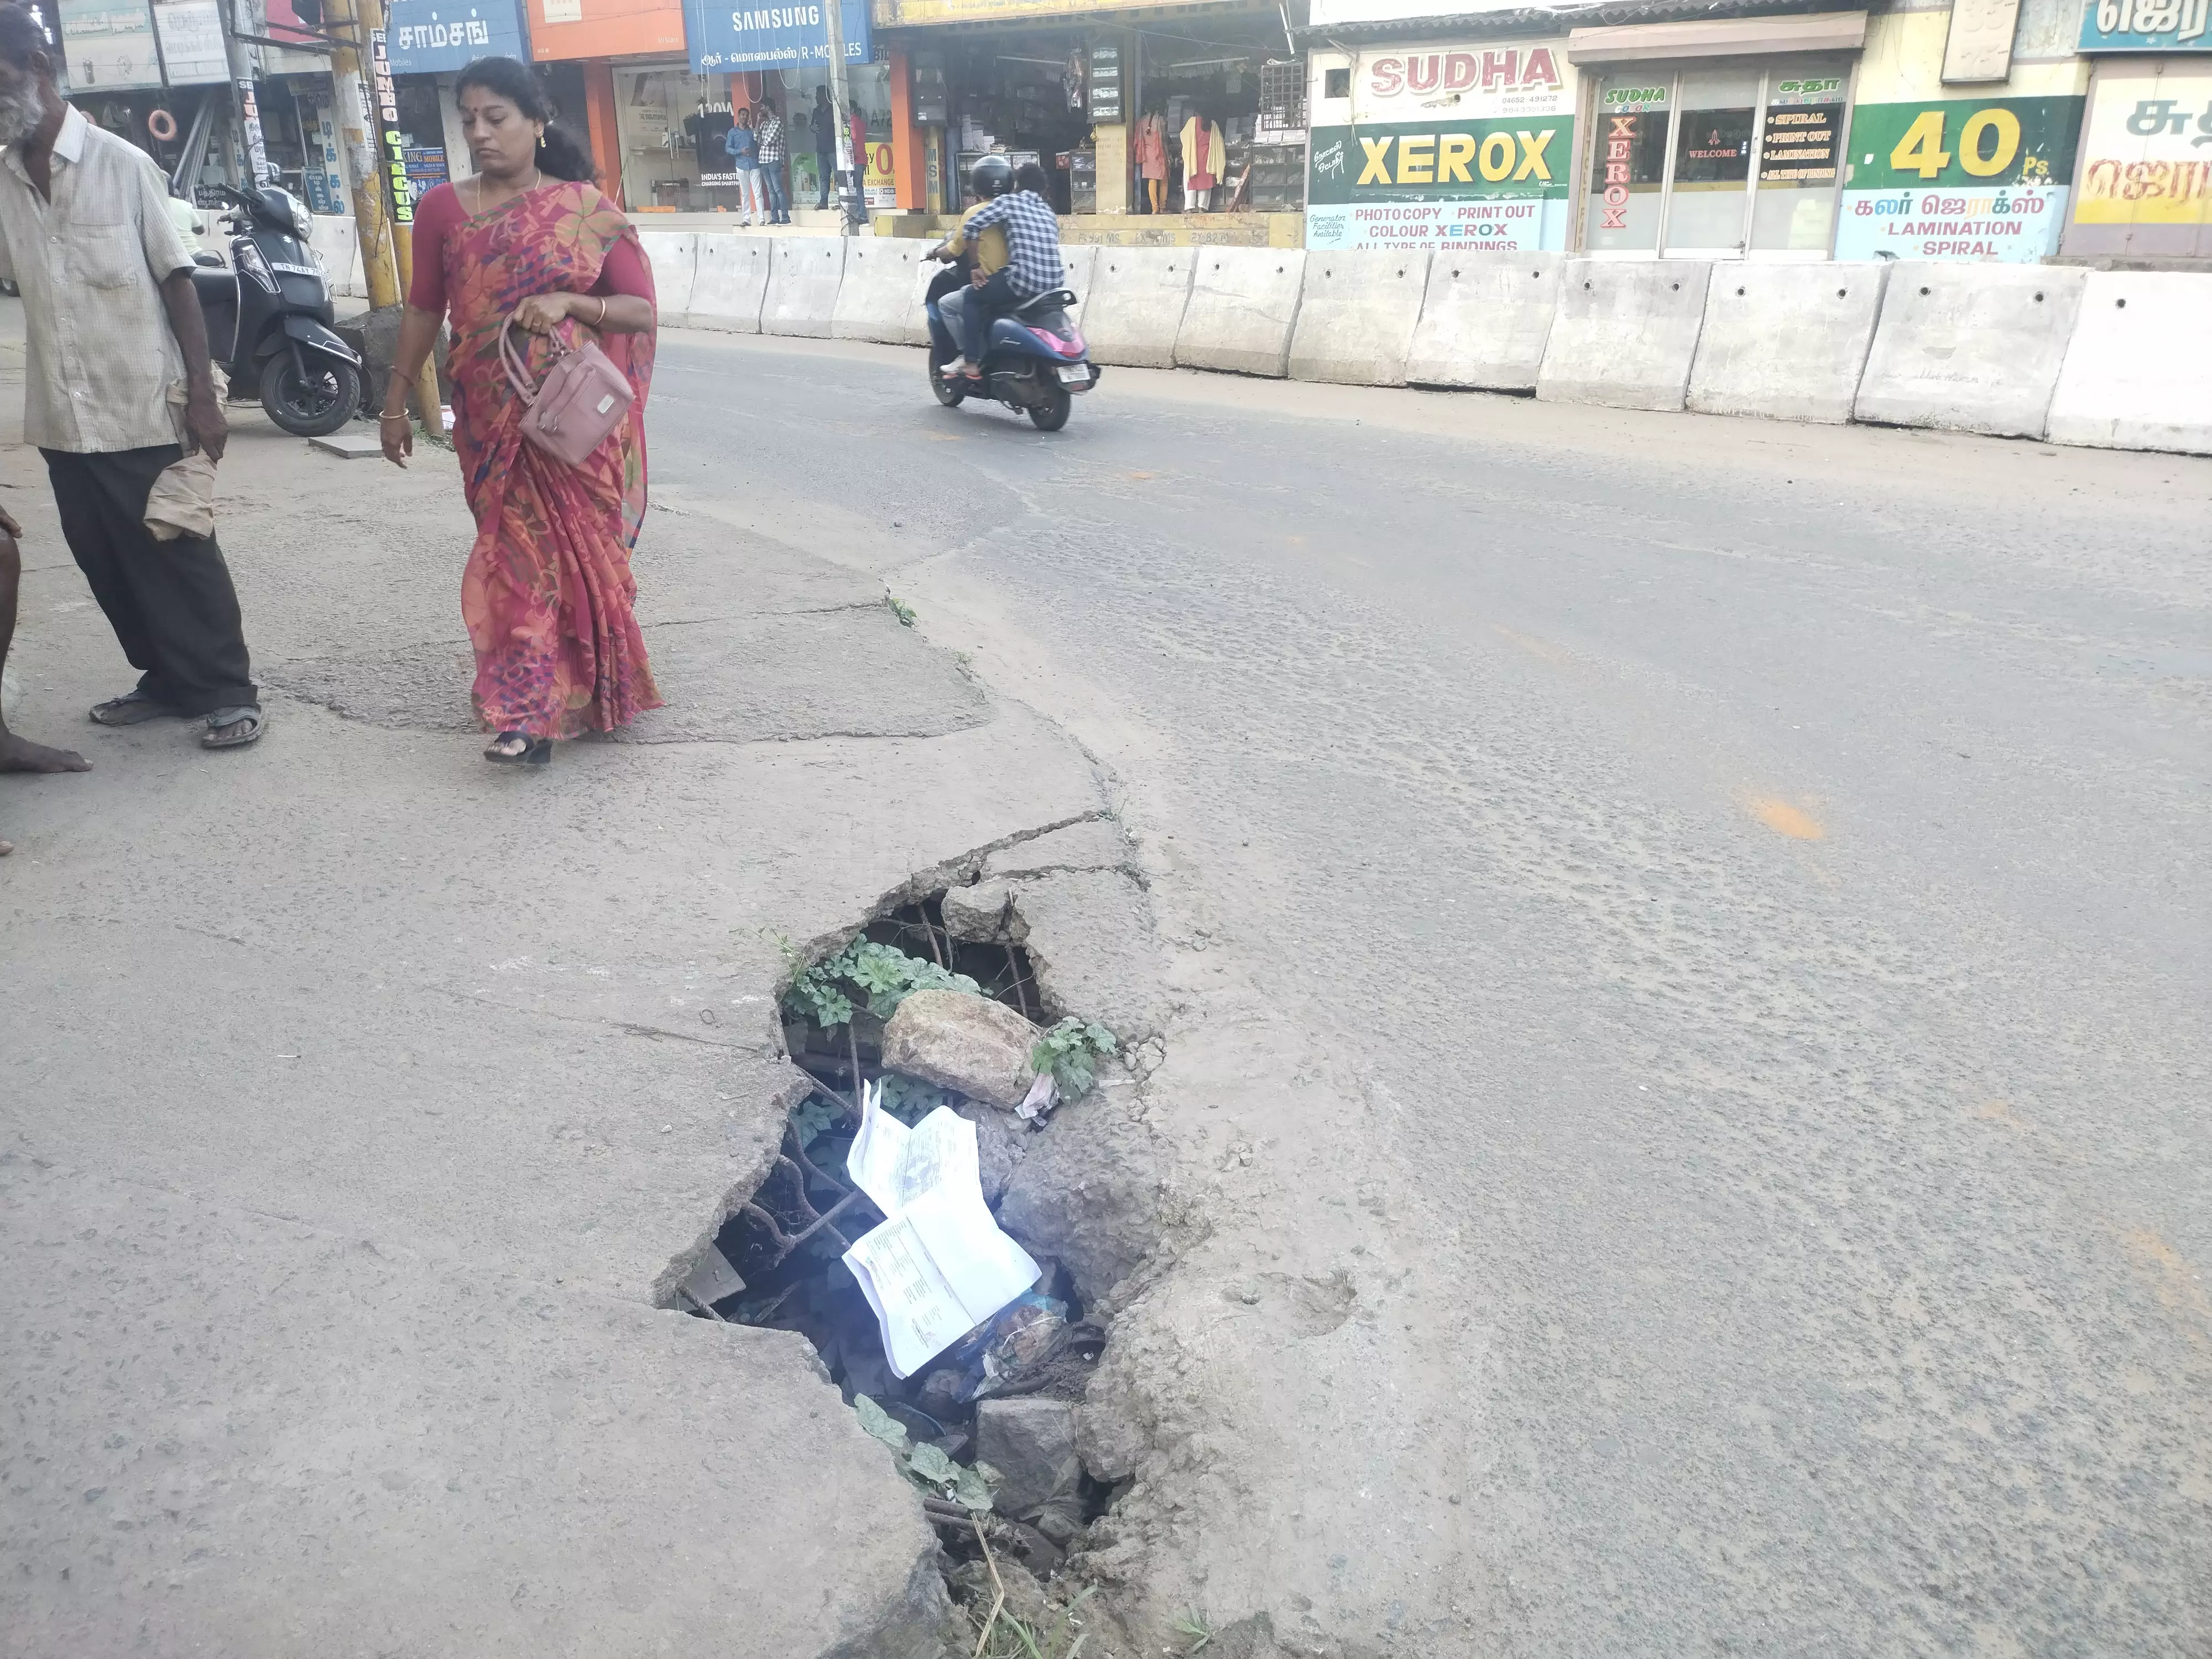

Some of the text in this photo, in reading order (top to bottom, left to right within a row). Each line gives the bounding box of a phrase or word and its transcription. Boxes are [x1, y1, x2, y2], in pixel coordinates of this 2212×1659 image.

[732, 6, 820, 31] SAMSUNG
[399, 8, 489, 50] சாம்சங்
[702, 52, 722, 66] ஆர்
[731, 47, 797, 62] மொபைல்ஸ்
[802, 42, 862, 59] R-MOLES
[389, 58, 412, 66] Mobiles
[1371, 48, 1558, 93] SUDHA
[374, 45, 398, 122] JUMBO
[1780, 79, 1840, 96] சுதா
[1605, 87, 1666, 104] SUDHA
[1776, 113, 1826, 124] SPIRAL
[1772, 131, 1831, 143] PRINT OUT
[1890, 108, 2021, 178] 40
[1357, 129, 1556, 185] XEROX
[1689, 149, 1737, 158] WELCOME
[1771, 149, 1830, 160] LAMINATION
[385, 131, 413, 220] CIRCUS
[1601, 116, 1636, 228] XEROX
[1767, 170, 1780, 180] ALL
[1781, 169, 1797, 179] TYPE
[1807, 168, 1835, 178] BINDING
[1854, 190, 2045, 220] கலர் ஜெராக்ஸ்
[1313, 229, 1343, 238] Available
[1369, 223, 1508, 237] COLOUR XEROX
[1888, 221, 2022, 236] LAMINATION
[1922, 241, 1999, 255] SPIRAL
